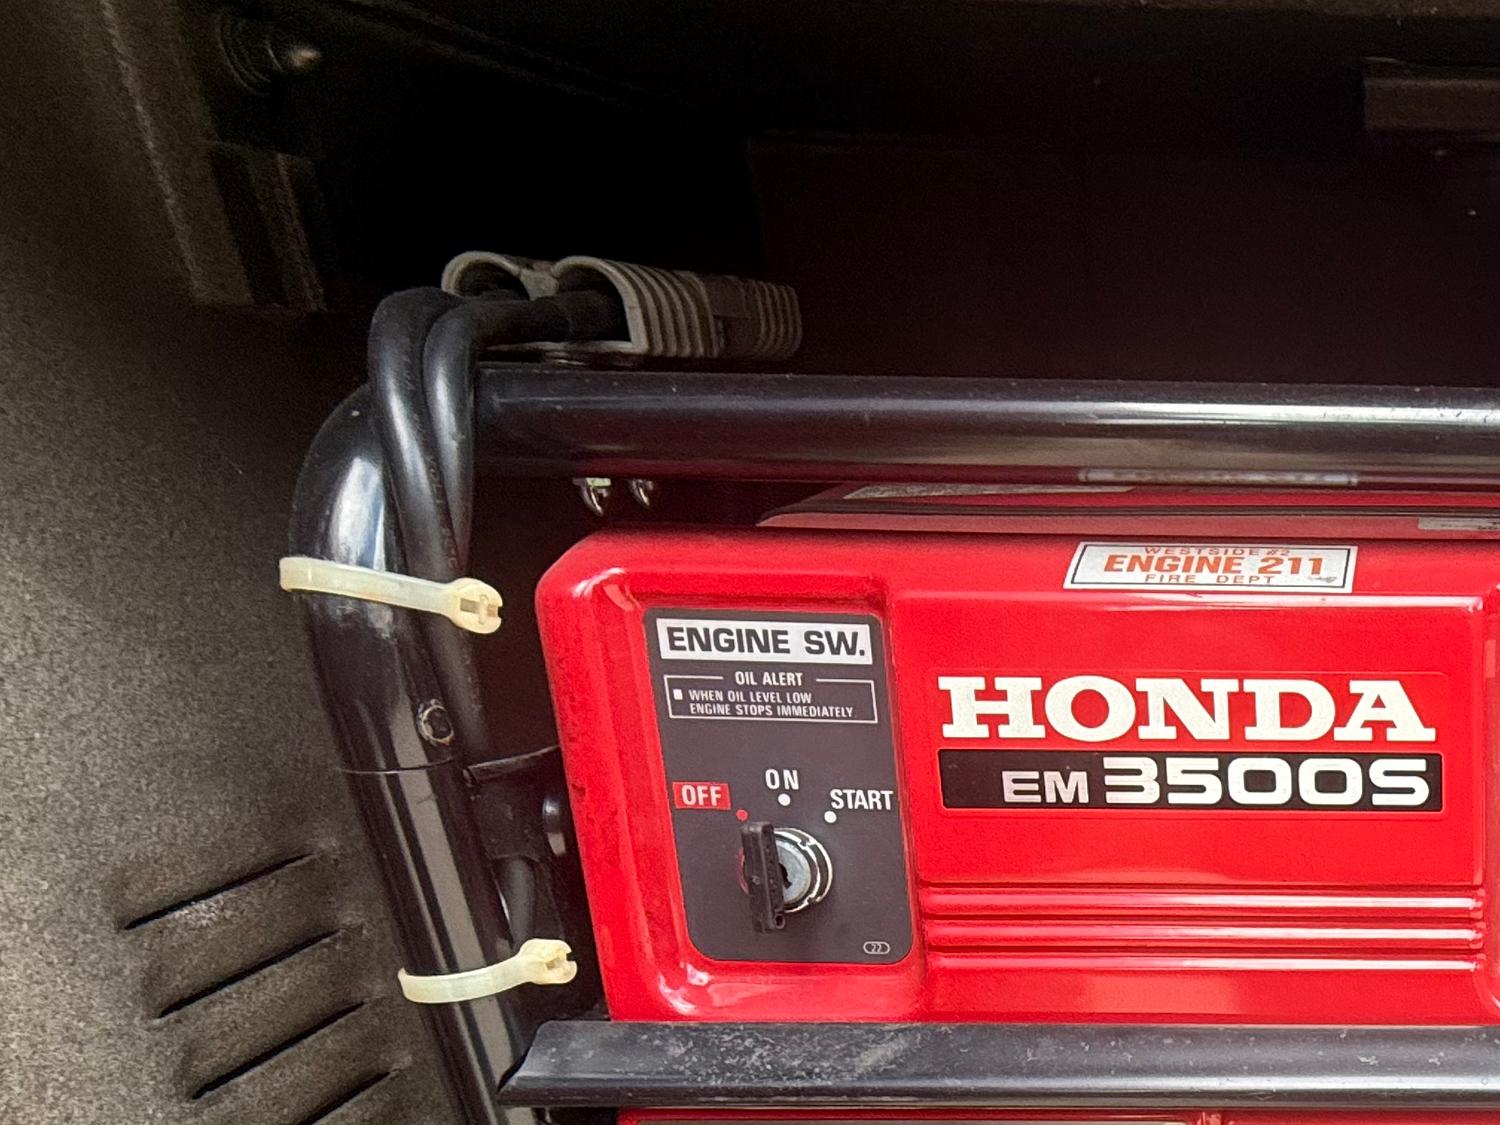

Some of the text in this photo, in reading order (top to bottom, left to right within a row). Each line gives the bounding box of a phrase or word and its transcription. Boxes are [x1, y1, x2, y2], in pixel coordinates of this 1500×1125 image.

[1104, 554, 1324, 575] ENGINE 211
[1145, 574, 1274, 585] FIRE DEPT
[667, 626, 866, 657] ENGINE SW.
[735, 671, 804, 687] OIL ALERT
[688, 689, 812, 704] WHEN OIL LEVEL LOW
[690, 703, 854, 718] ENGINE STOPS IMMEDIATELY
[937, 675, 1436, 742] HONDA
[765, 769, 799, 790] ON
[1002, 756, 1430, 807] EM 3500S
[681, 785, 722, 807] OFF
[830, 789, 894, 811] START
